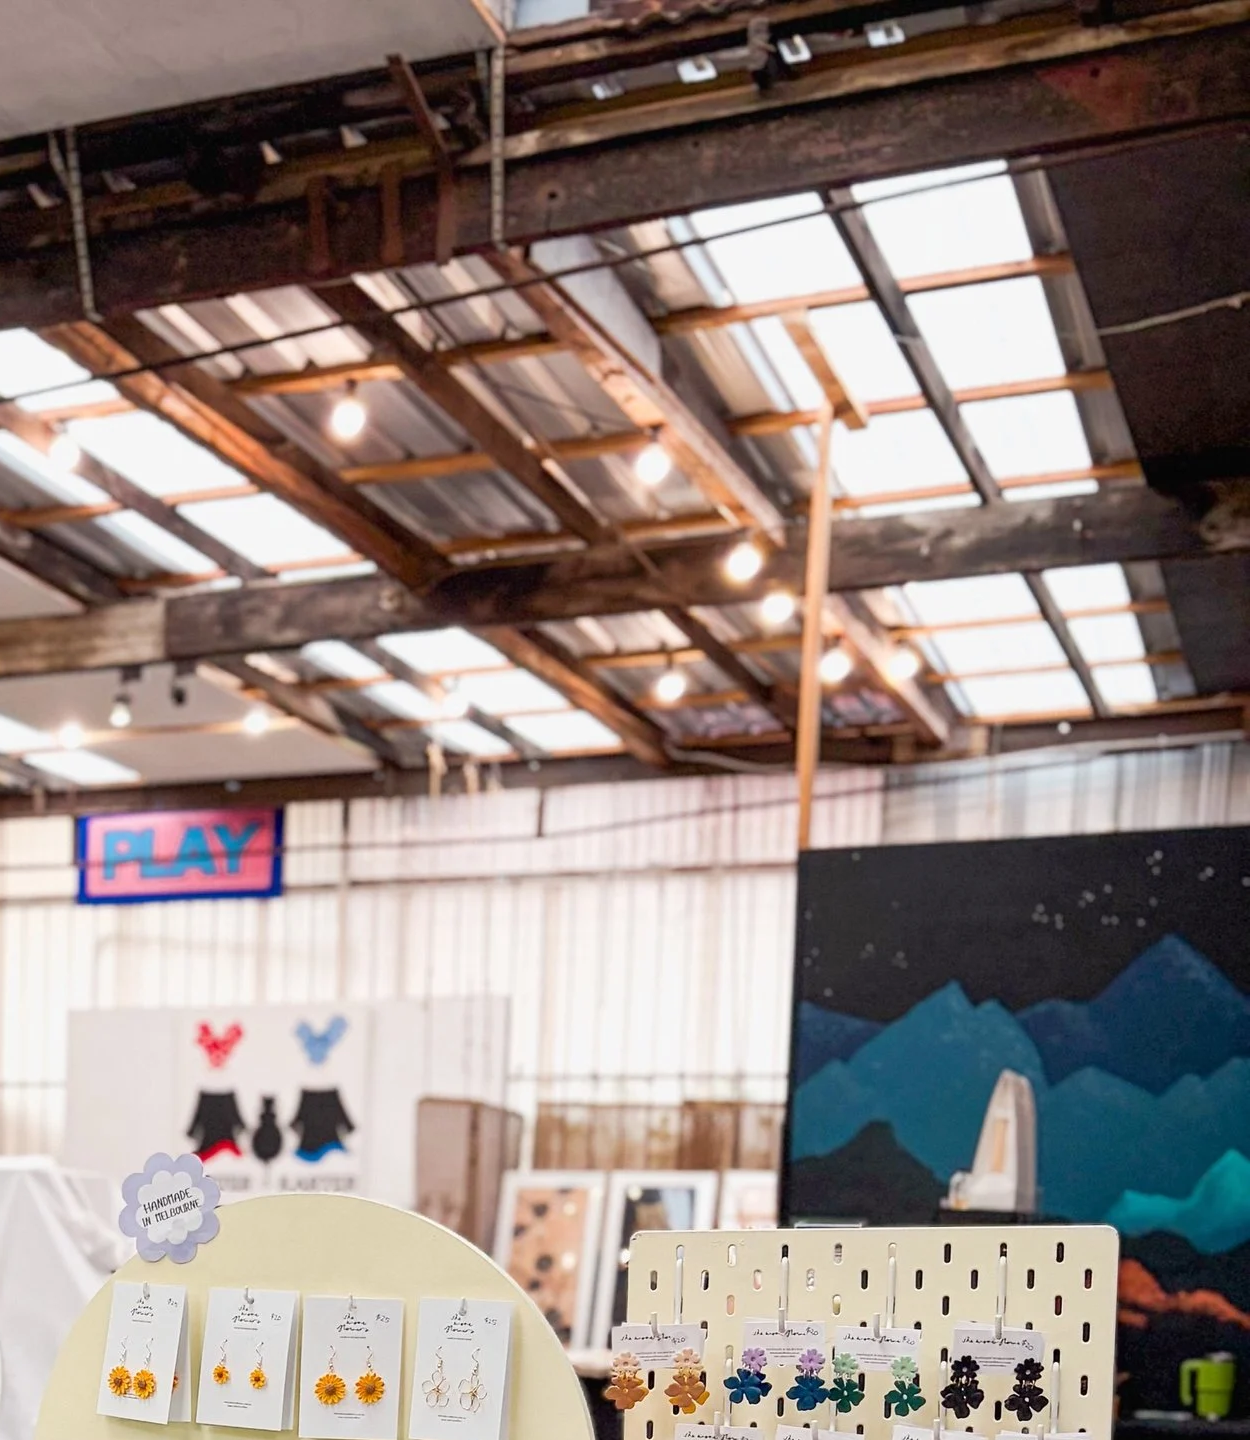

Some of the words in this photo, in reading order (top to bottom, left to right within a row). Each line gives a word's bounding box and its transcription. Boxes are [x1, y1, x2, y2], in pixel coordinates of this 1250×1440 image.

[103, 821, 261, 880] PLAY
[141, 1216, 152, 1227] IN
[154, 1199, 201, 1224] MELBOURNE
[143, 1187, 193, 1214] HANDMADE
